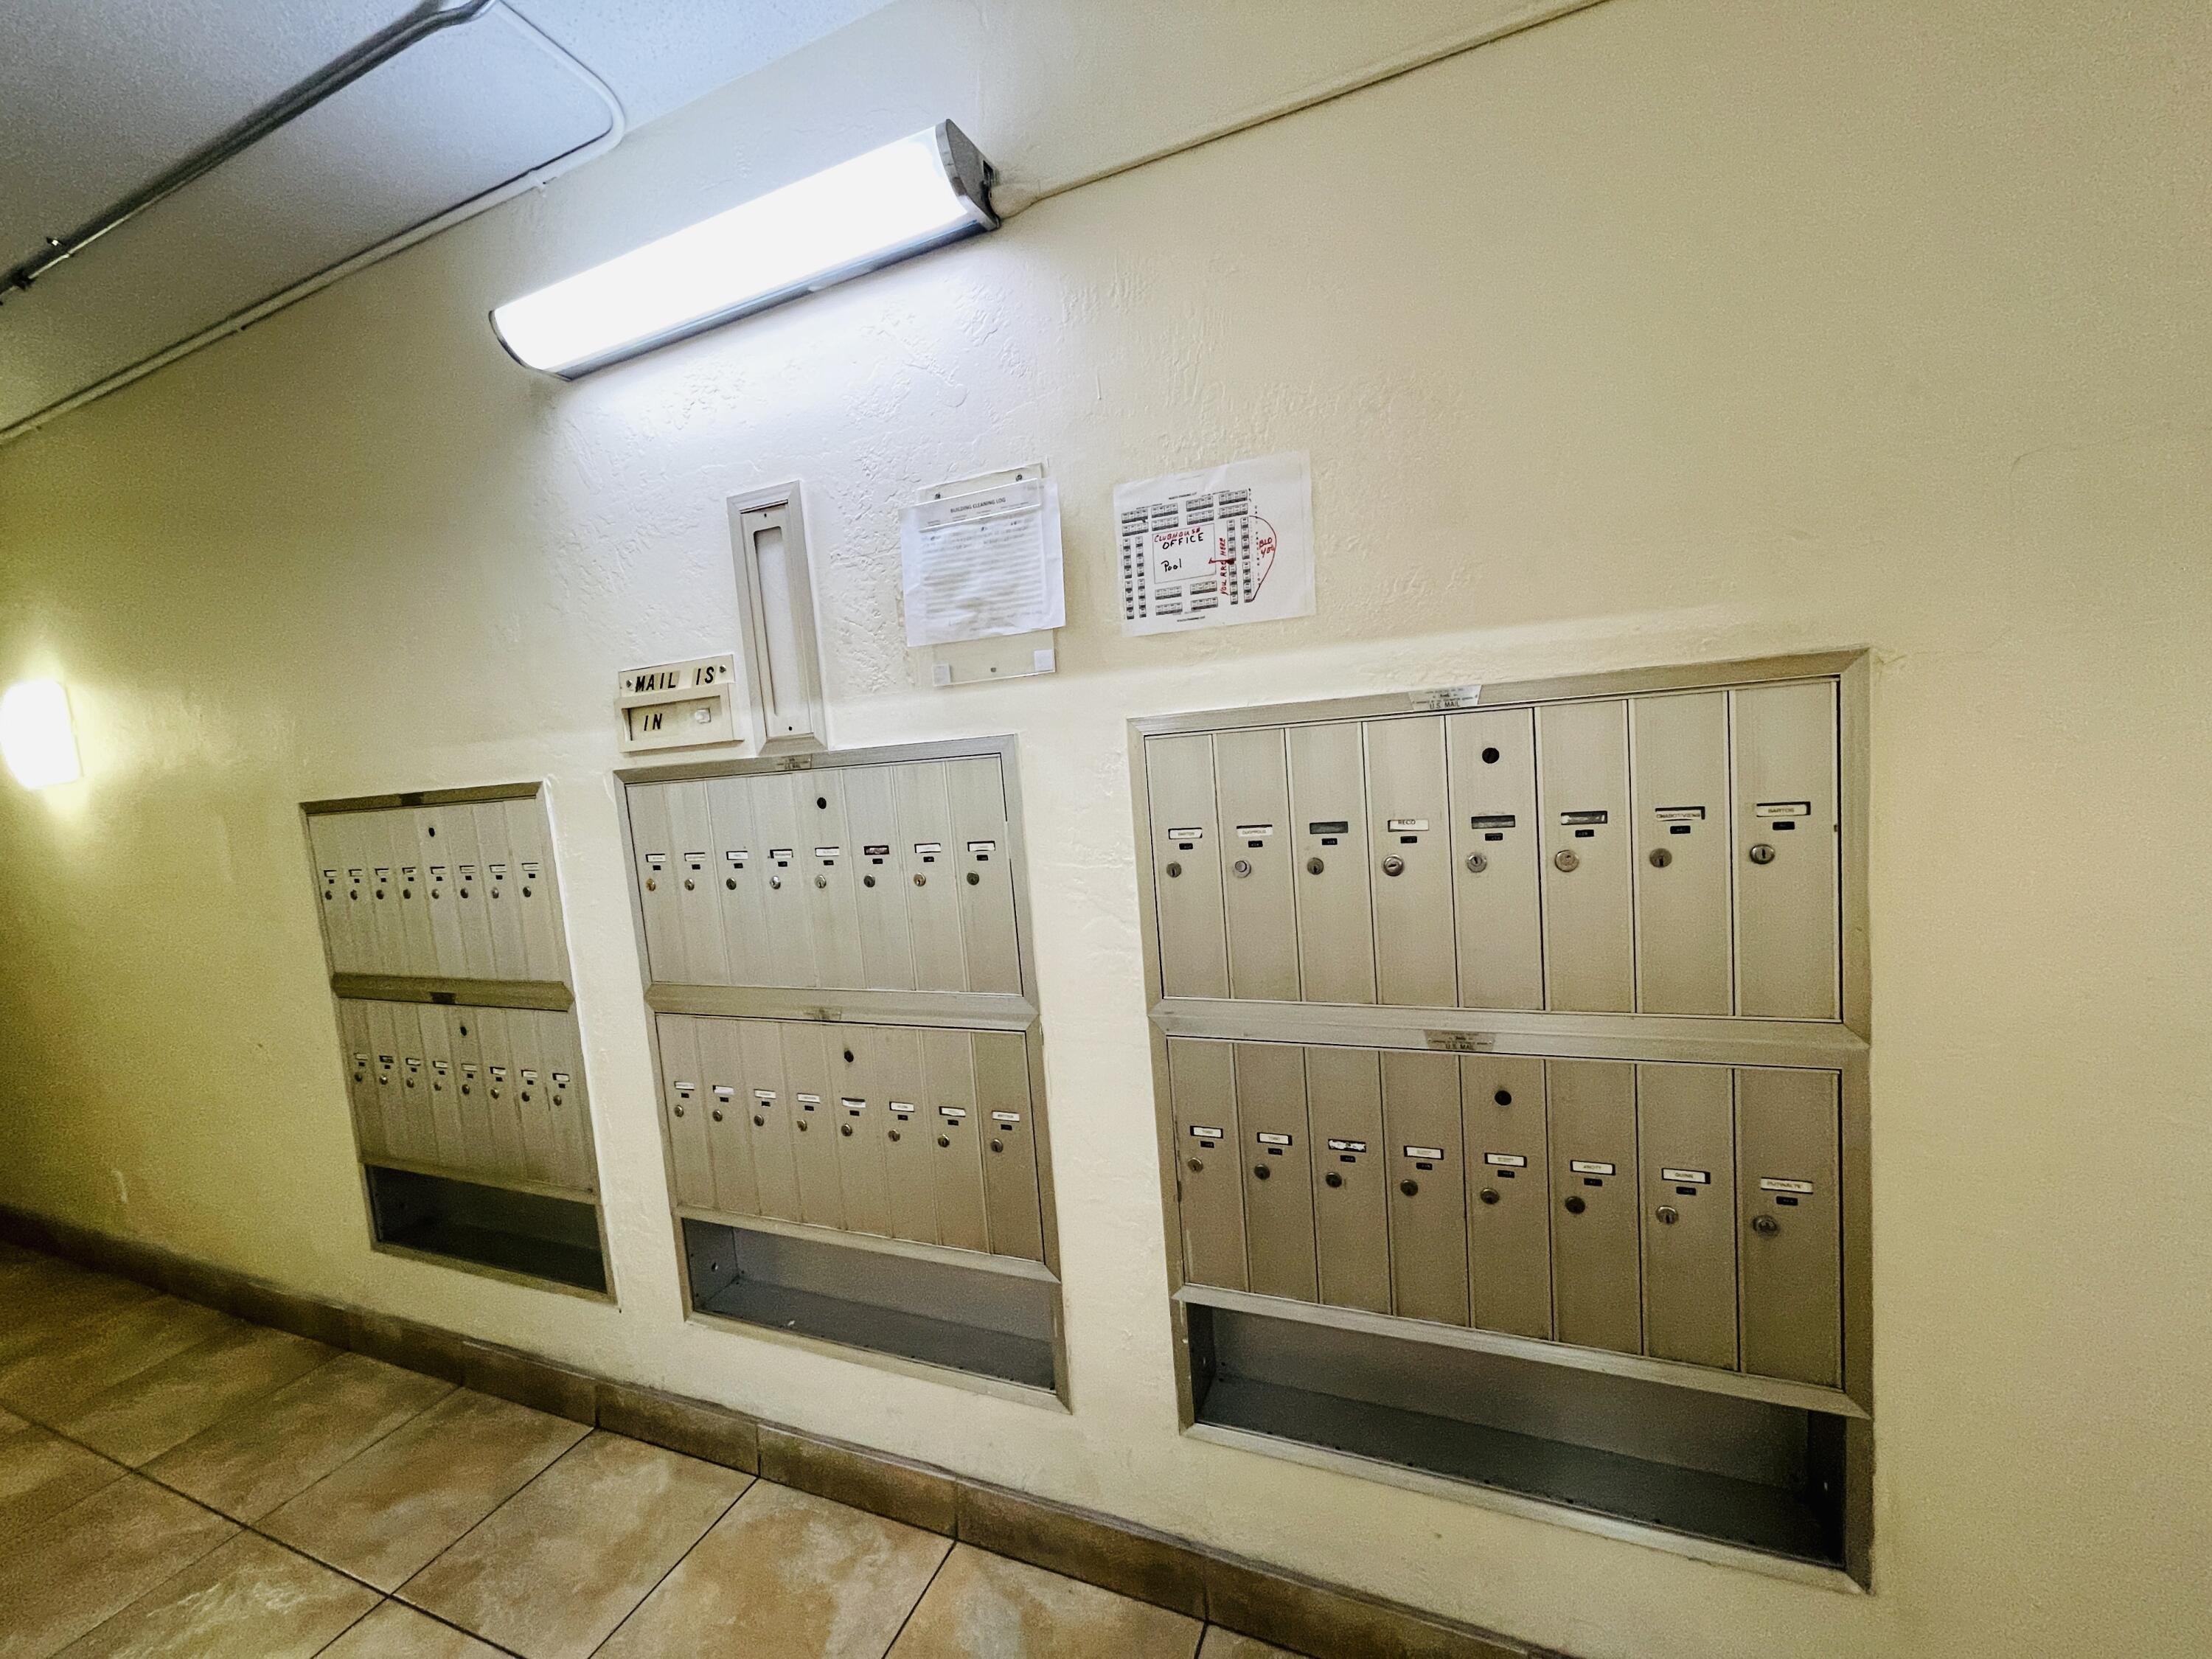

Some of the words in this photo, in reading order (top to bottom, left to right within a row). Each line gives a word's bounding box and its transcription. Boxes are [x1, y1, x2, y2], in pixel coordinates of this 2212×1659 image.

[950, 504, 972, 513] BUILDING
[973, 500, 995, 509] CLEANING
[1162, 532, 1203, 549] OFFICE
[1161, 558, 1182, 572] Pool
[635, 672, 677, 692] MAIL
[696, 666, 714, 686] IS
[643, 713, 663, 731] IN
